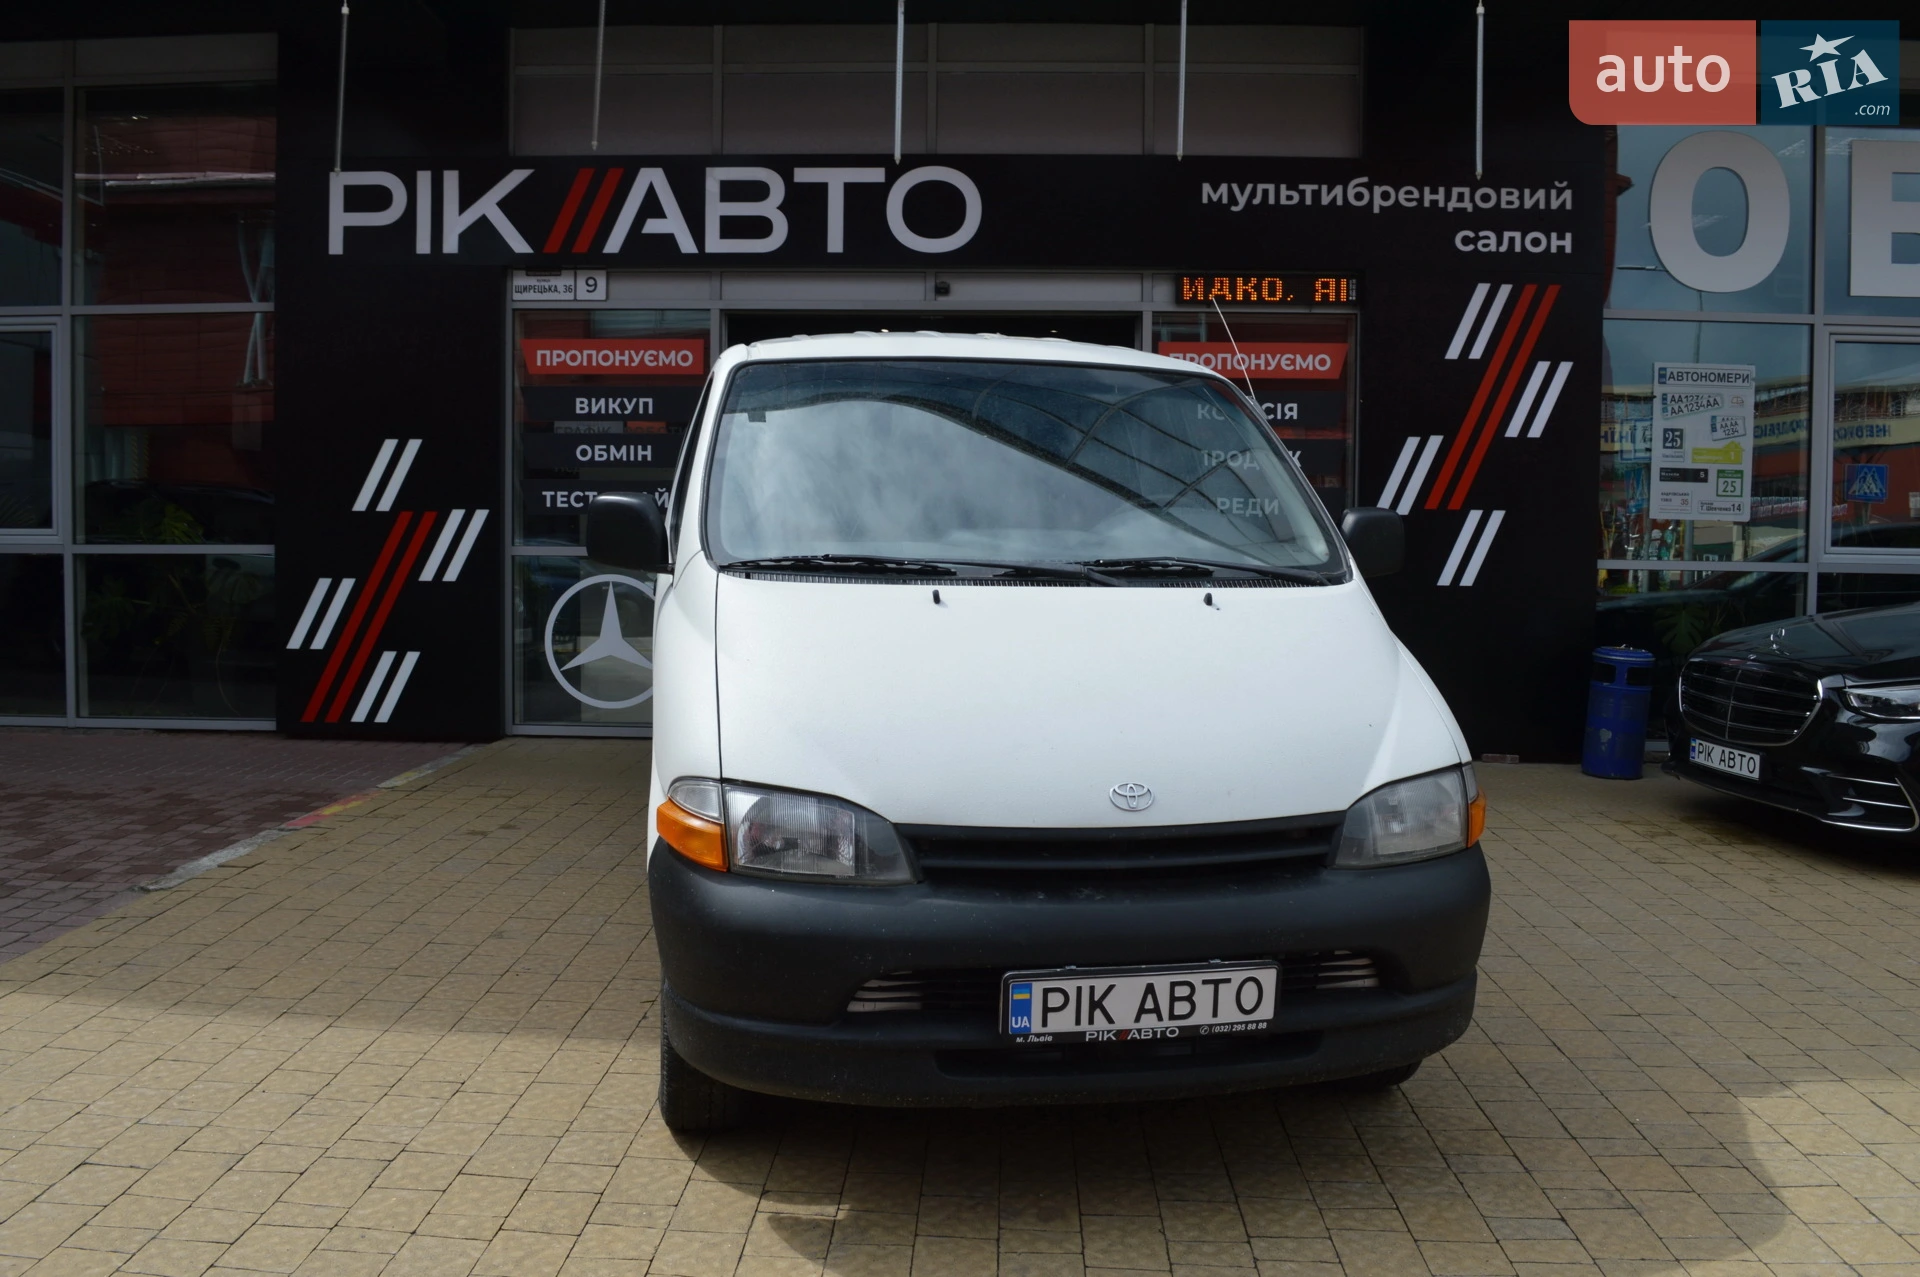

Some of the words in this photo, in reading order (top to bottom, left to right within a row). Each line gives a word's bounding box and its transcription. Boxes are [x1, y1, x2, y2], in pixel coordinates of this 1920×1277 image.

[1201, 176, 1573, 214] мультибрендовий
[1454, 230, 1573, 254] салон
[562, 284, 573, 294] 36
[584, 276, 598, 294] 9
[536, 350, 693, 367] ПРОПОНУЄМО
[1668, 371, 1750, 383] АВТОНОМЕРИ
[575, 398, 653, 414] ВИКУП
[1664, 431, 1681, 447] 25
[576, 445, 652, 462] ОБМІН
[1722, 480, 1737, 493] 25
[1731, 503, 1742, 512] 14
[1697, 742, 1715, 764] РІК
[1718, 749, 1756, 775] АВТО
[1041, 983, 1117, 1028] РІК
[1133, 976, 1264, 1024] АВТО
[1011, 1016, 1030, 1028] UA
